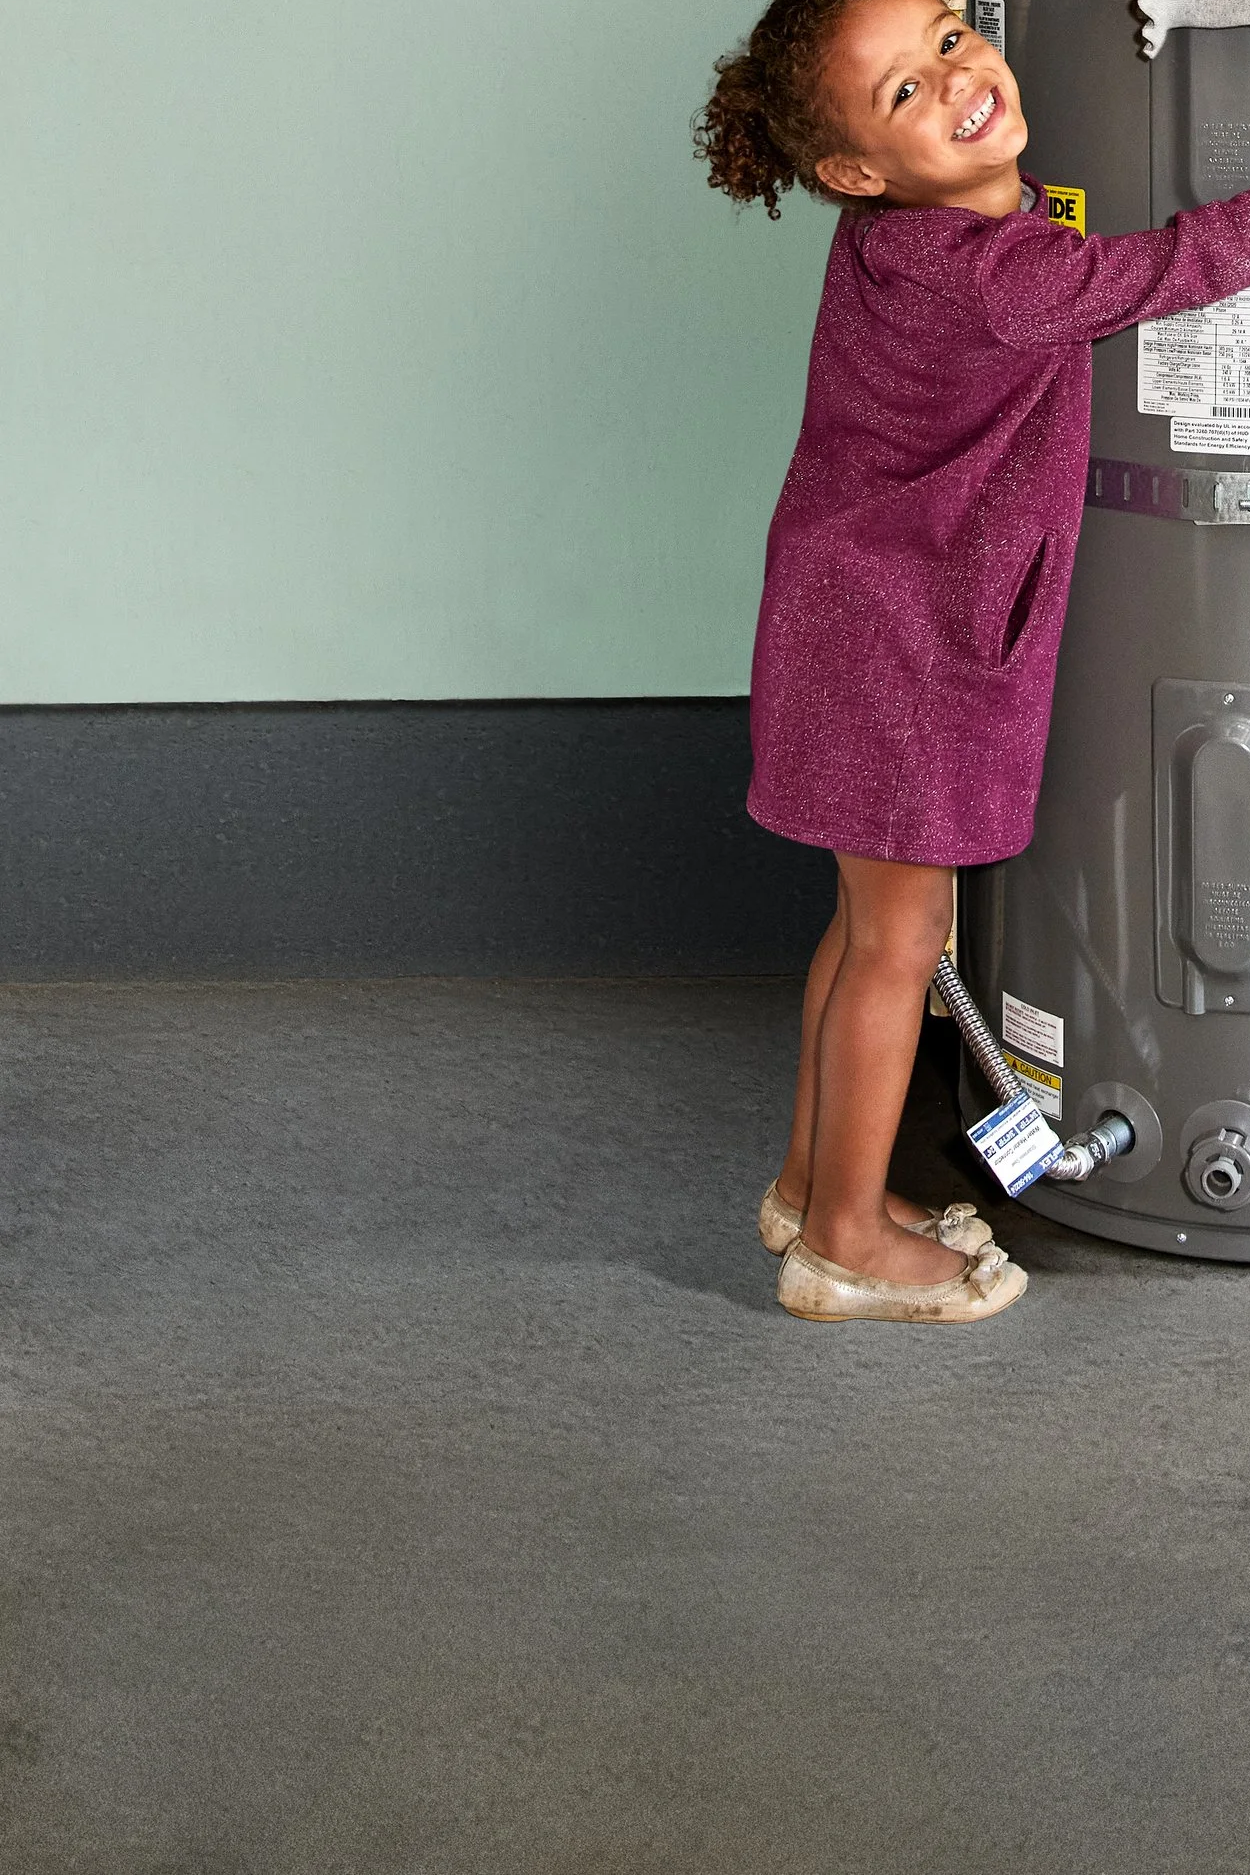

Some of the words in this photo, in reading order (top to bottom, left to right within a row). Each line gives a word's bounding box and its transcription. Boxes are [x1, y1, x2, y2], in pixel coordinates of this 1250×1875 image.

[1020, 1064, 1052, 1085] CAUTION
[1026, 1125, 1041, 1139] Water
[1012, 1137, 1027, 1151] Heater
